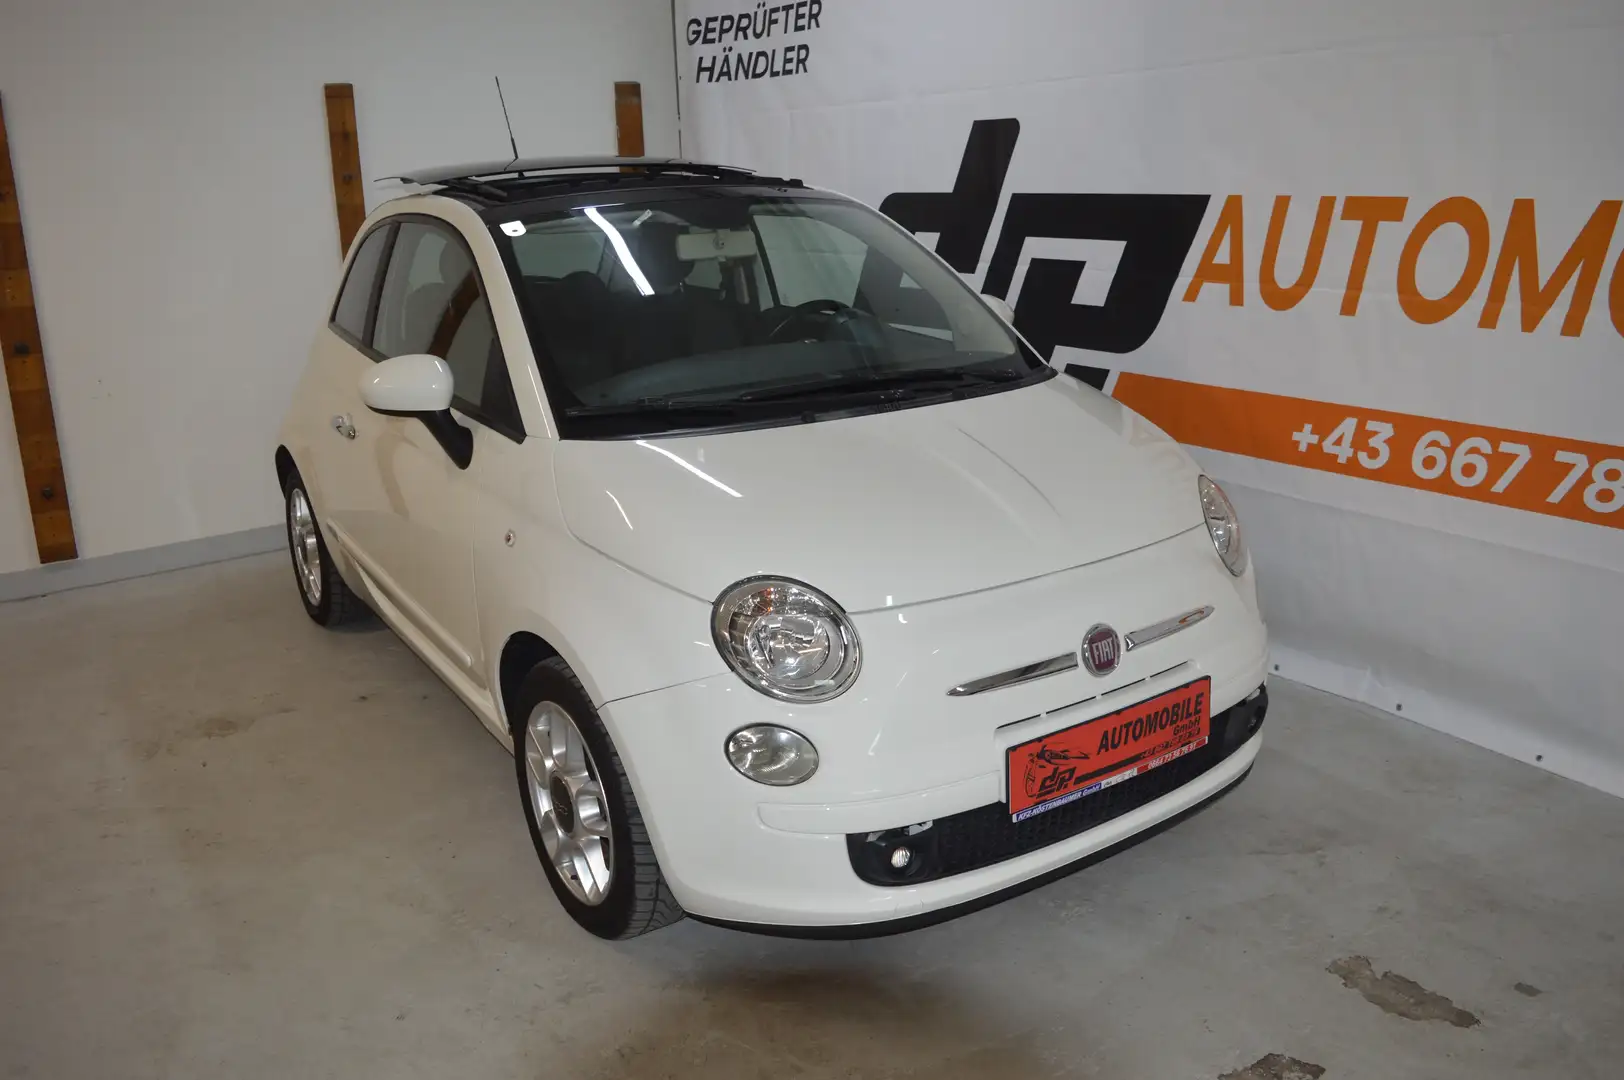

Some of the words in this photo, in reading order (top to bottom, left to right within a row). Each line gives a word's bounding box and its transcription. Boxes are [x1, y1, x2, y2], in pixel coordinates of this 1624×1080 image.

[686, 0, 822, 46] GEPRÜFTER
[696, 44, 809, 83] HÄNDLER
[1182, 195, 1624, 342] AUTOM
[1291, 417, 1395, 470] +43
[1411, 430, 1532, 494] 667
[1545, 450, 1624, 513] 78
[1092, 637, 1113, 665] FIAT
[1097, 692, 1204, 756] AUTOMOBILE
[1173, 716, 1201, 736] GmbH
